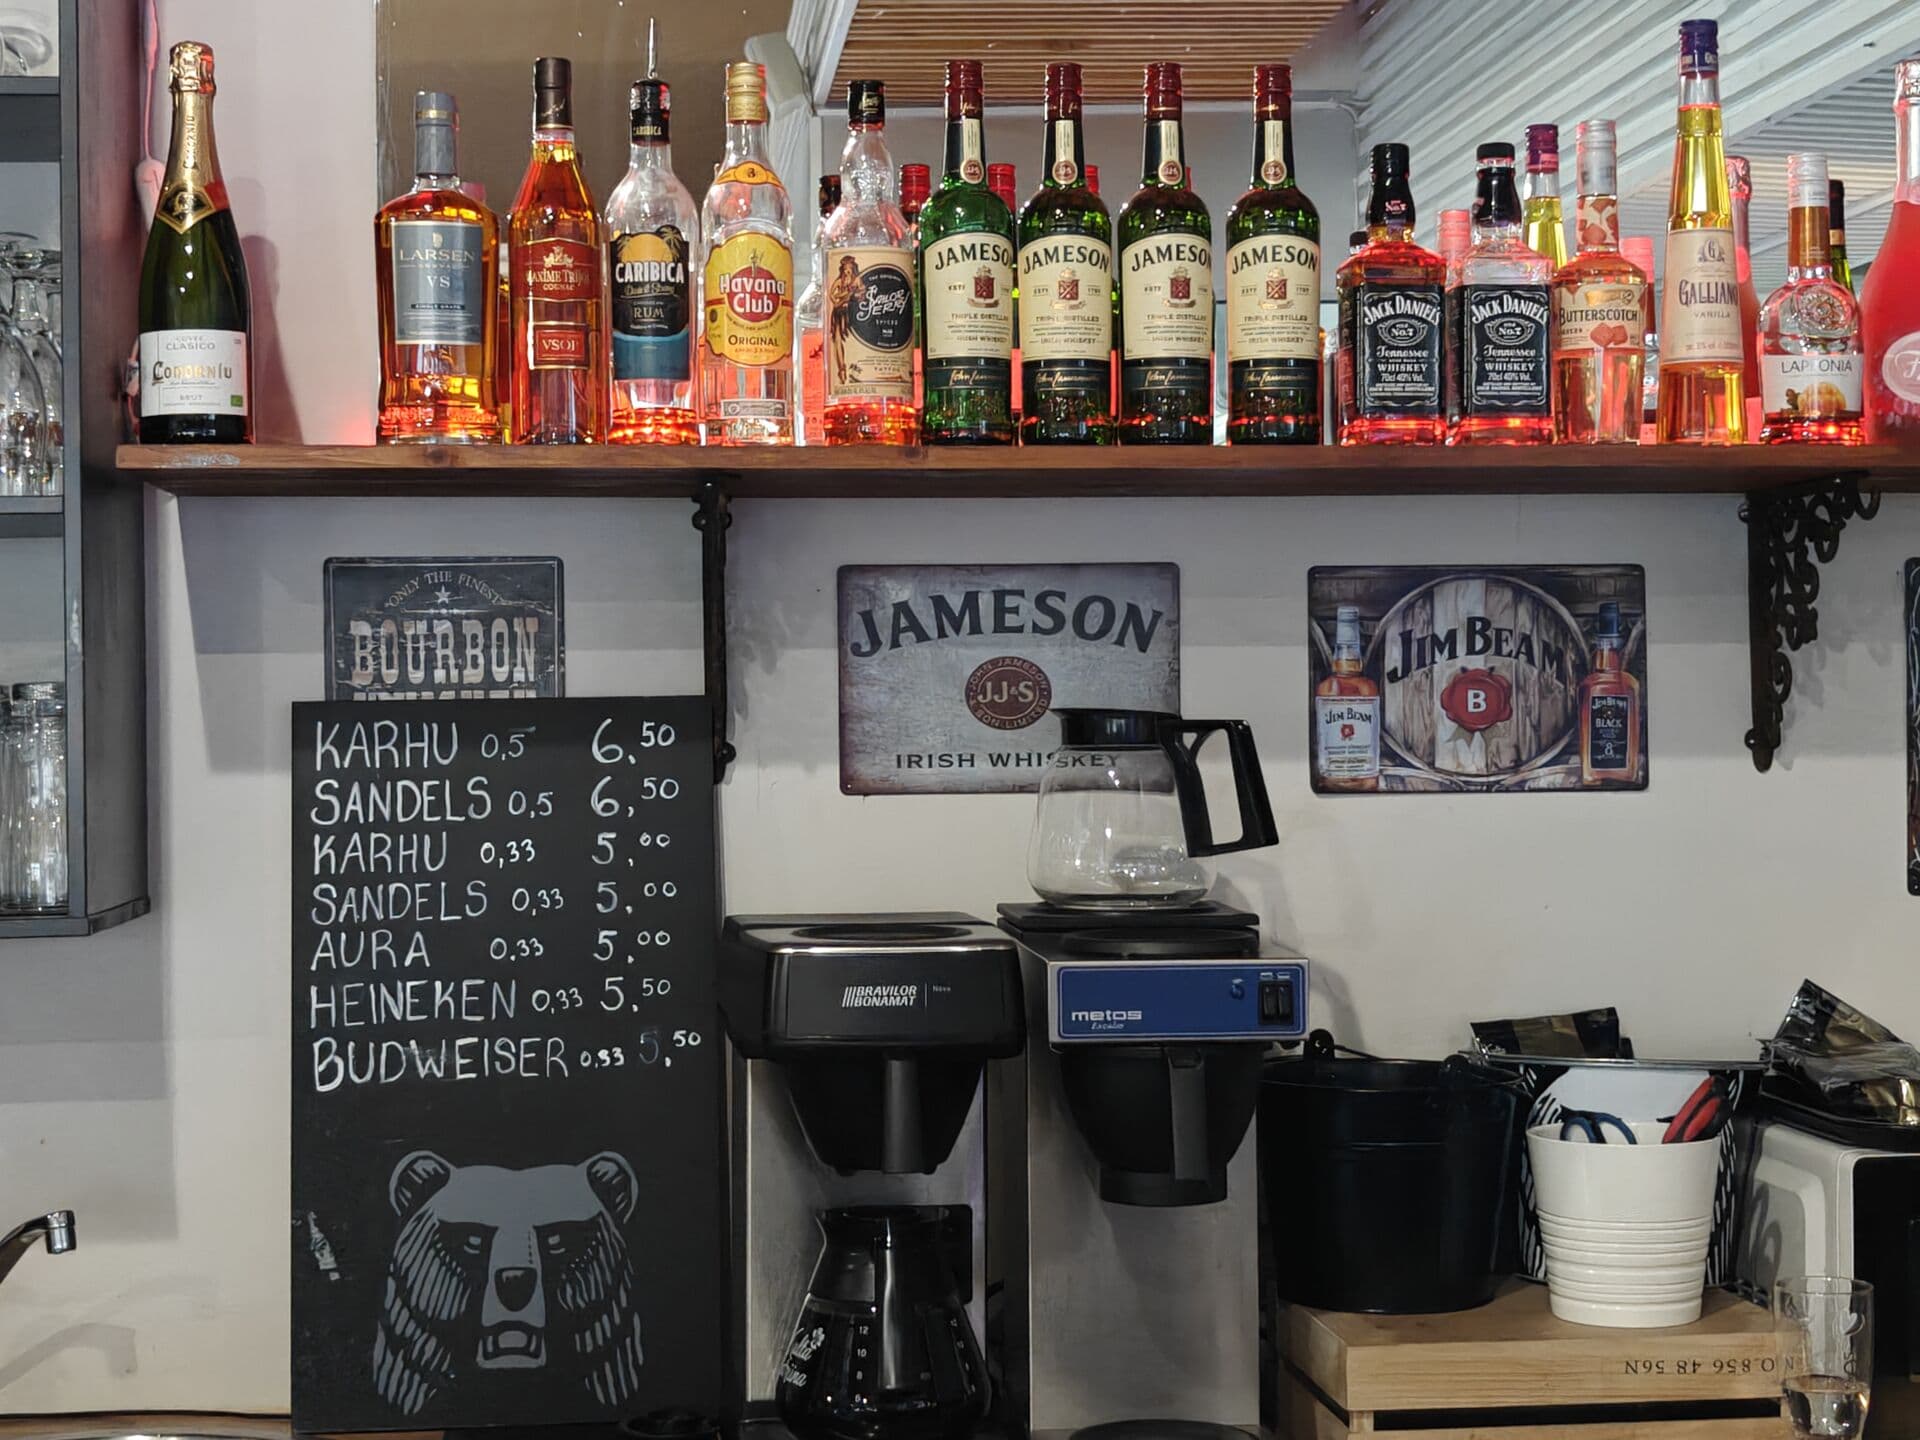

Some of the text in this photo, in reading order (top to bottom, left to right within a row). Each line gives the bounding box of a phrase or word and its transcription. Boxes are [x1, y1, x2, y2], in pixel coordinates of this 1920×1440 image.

[400, 248, 475, 261] LARSEN
[1023, 245, 1110, 274] JAMESON
[1231, 244, 1318, 275] JAMESON
[427, 275, 451, 288] VS
[615, 261, 685, 284] CARIBICA
[719, 273, 785, 295] Havana
[733, 293, 773, 313] Club
[1363, 295, 1441, 326] JACK DANIEL'S
[1471, 299, 1501, 324] JACK
[634, 307, 665, 318] RUM
[728, 334, 780, 347] ORIGINAL
[1376, 345, 1429, 357] Tennessee
[1483, 344, 1536, 357] Tennessee
[1377, 363, 1428, 371] WHISKEY
[1485, 363, 1536, 371] WHISKEY
[1781, 359, 1853, 374] LAPONIA
[389, 570, 505, 607] ONLY THE FINEST
[849, 588, 1164, 658] JAMESON
[349, 617, 540, 685] BOURBON
[1386, 615, 1568, 689] JIM BEAM
[1466, 689, 1487, 713] B
[1325, 709, 1345, 724] JIM
[316, 720, 459, 771] KARHU
[1604, 742, 1614, 756] 8
[896, 753, 976, 769] IRISH
[310, 776, 492, 825] SANDELS
[508, 790, 554, 818] 0,5
[313, 832, 448, 875] KARHU
[480, 839, 536, 868] 0,33
[311, 880, 488, 925] SANDELS
[511, 887, 565, 916] 0,33
[310, 929, 431, 971] AURA
[857, 985, 918, 996] BRAVILOR
[310, 979, 516, 1028] HEINEKEN
[531, 987, 584, 1015] 0,33
[854, 996, 917, 1007] BONAMAT
[1071, 1010, 1143, 1021] metos
[312, 1036, 569, 1093] BUDWEISER
[859, 1326, 869, 1335] 12
[857, 1349, 867, 1357] 10
[856, 1371, 863, 1380] 8
[1676, 1359, 1702, 1374] 48
